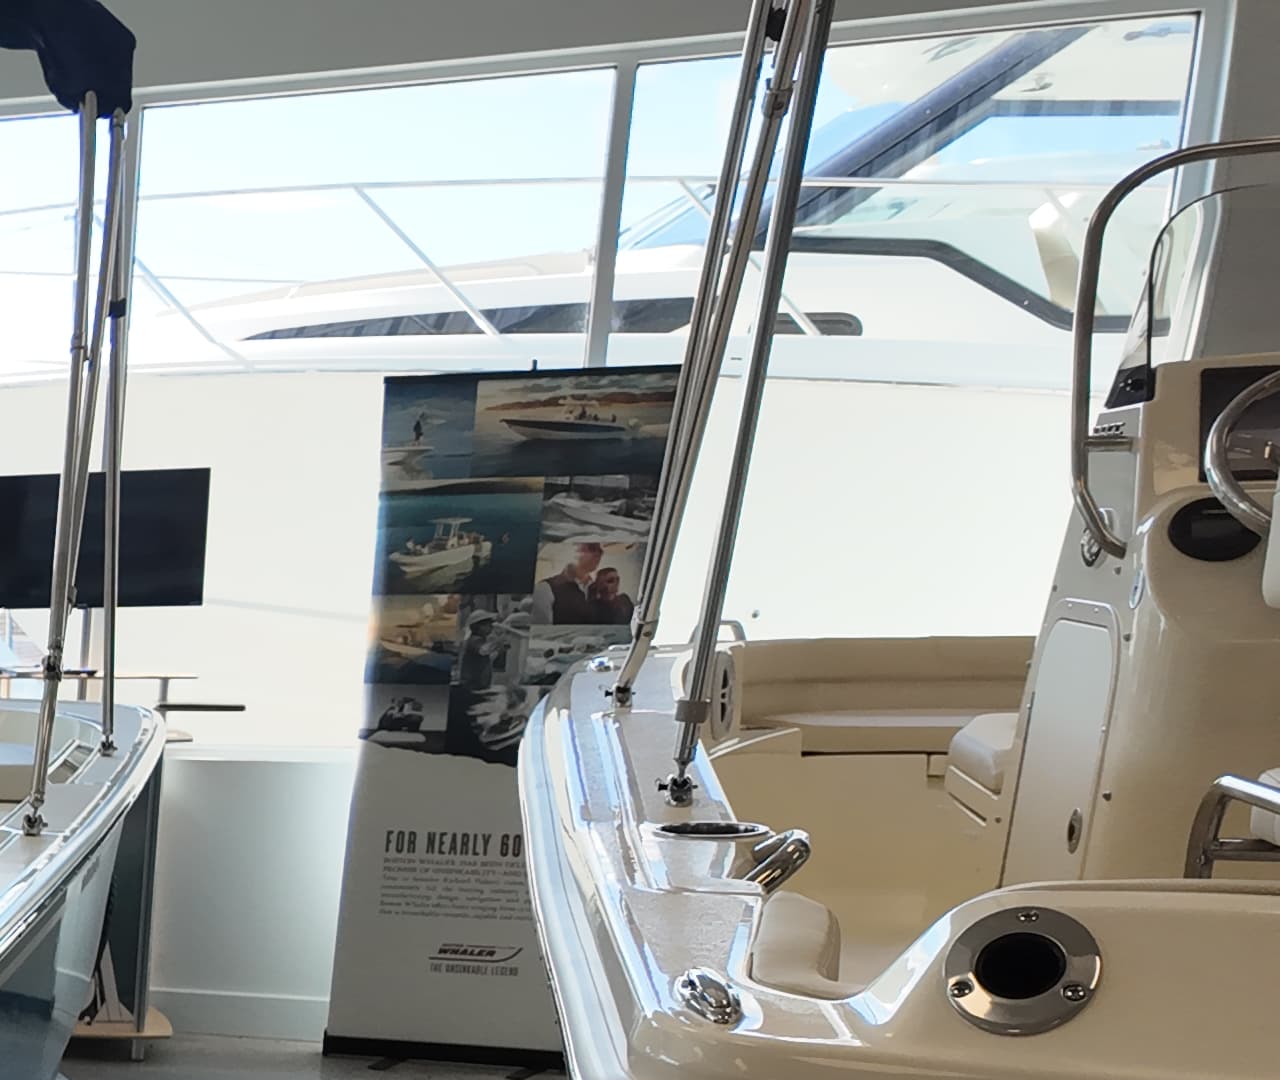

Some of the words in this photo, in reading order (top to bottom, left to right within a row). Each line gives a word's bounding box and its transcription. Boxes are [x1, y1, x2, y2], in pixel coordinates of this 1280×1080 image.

[385, 830, 417, 854] FOR
[426, 832, 492, 857] NEARLY
[499, 834, 522, 858] 60
[437, 948, 497, 957] WHALER
